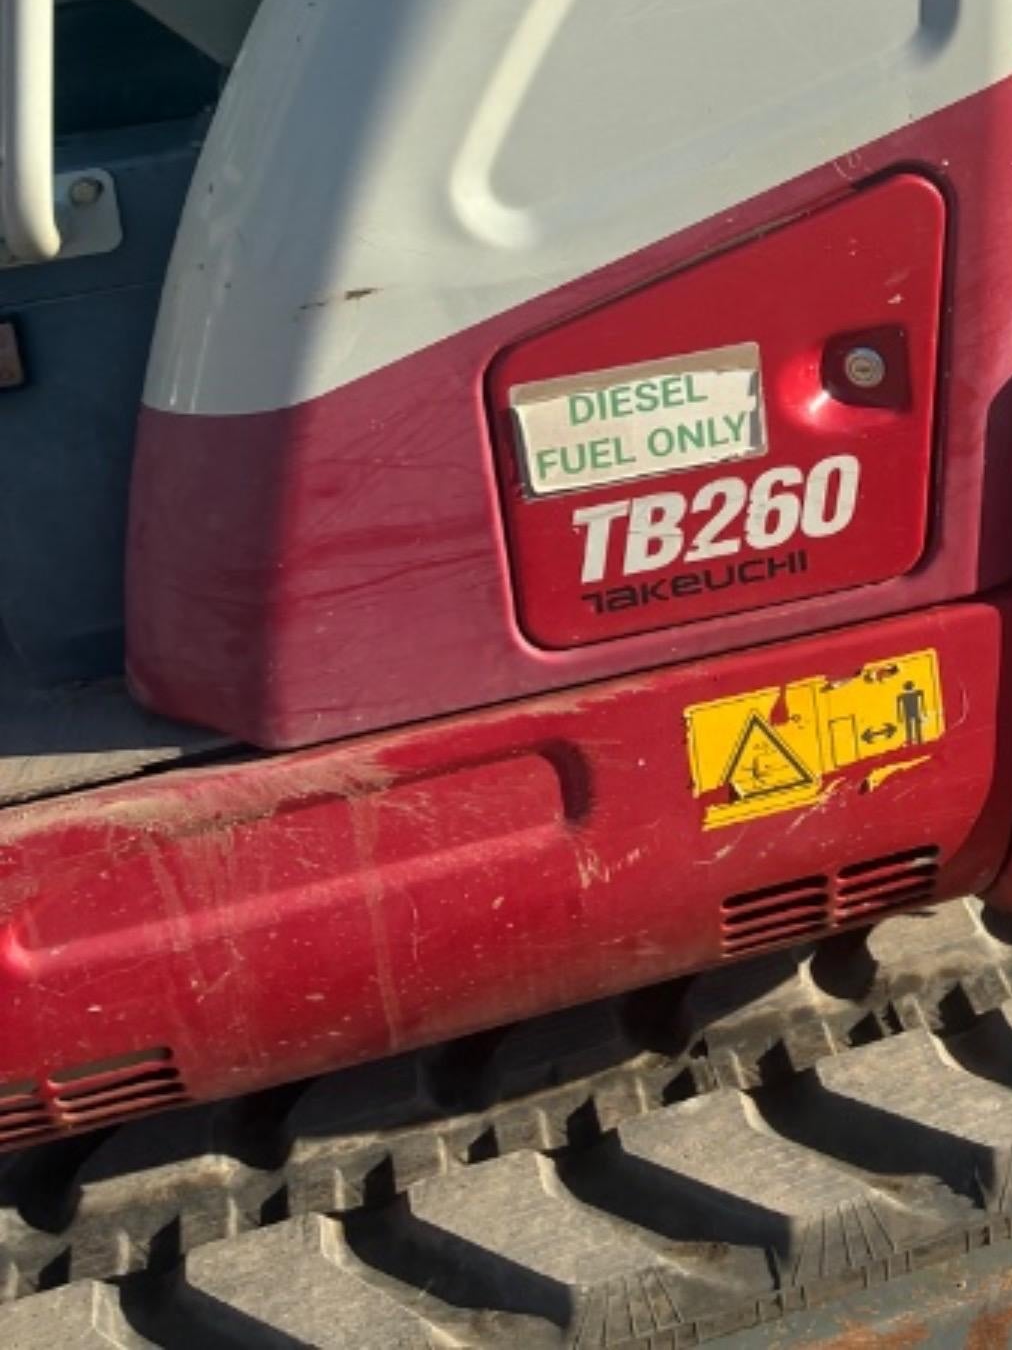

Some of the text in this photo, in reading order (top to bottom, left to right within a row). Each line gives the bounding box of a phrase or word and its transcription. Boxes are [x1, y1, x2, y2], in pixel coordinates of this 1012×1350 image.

[568, 374, 708, 426] DIESEL
[535, 410, 748, 481] FUEL ONLY
[572, 455, 861, 584] TB260
